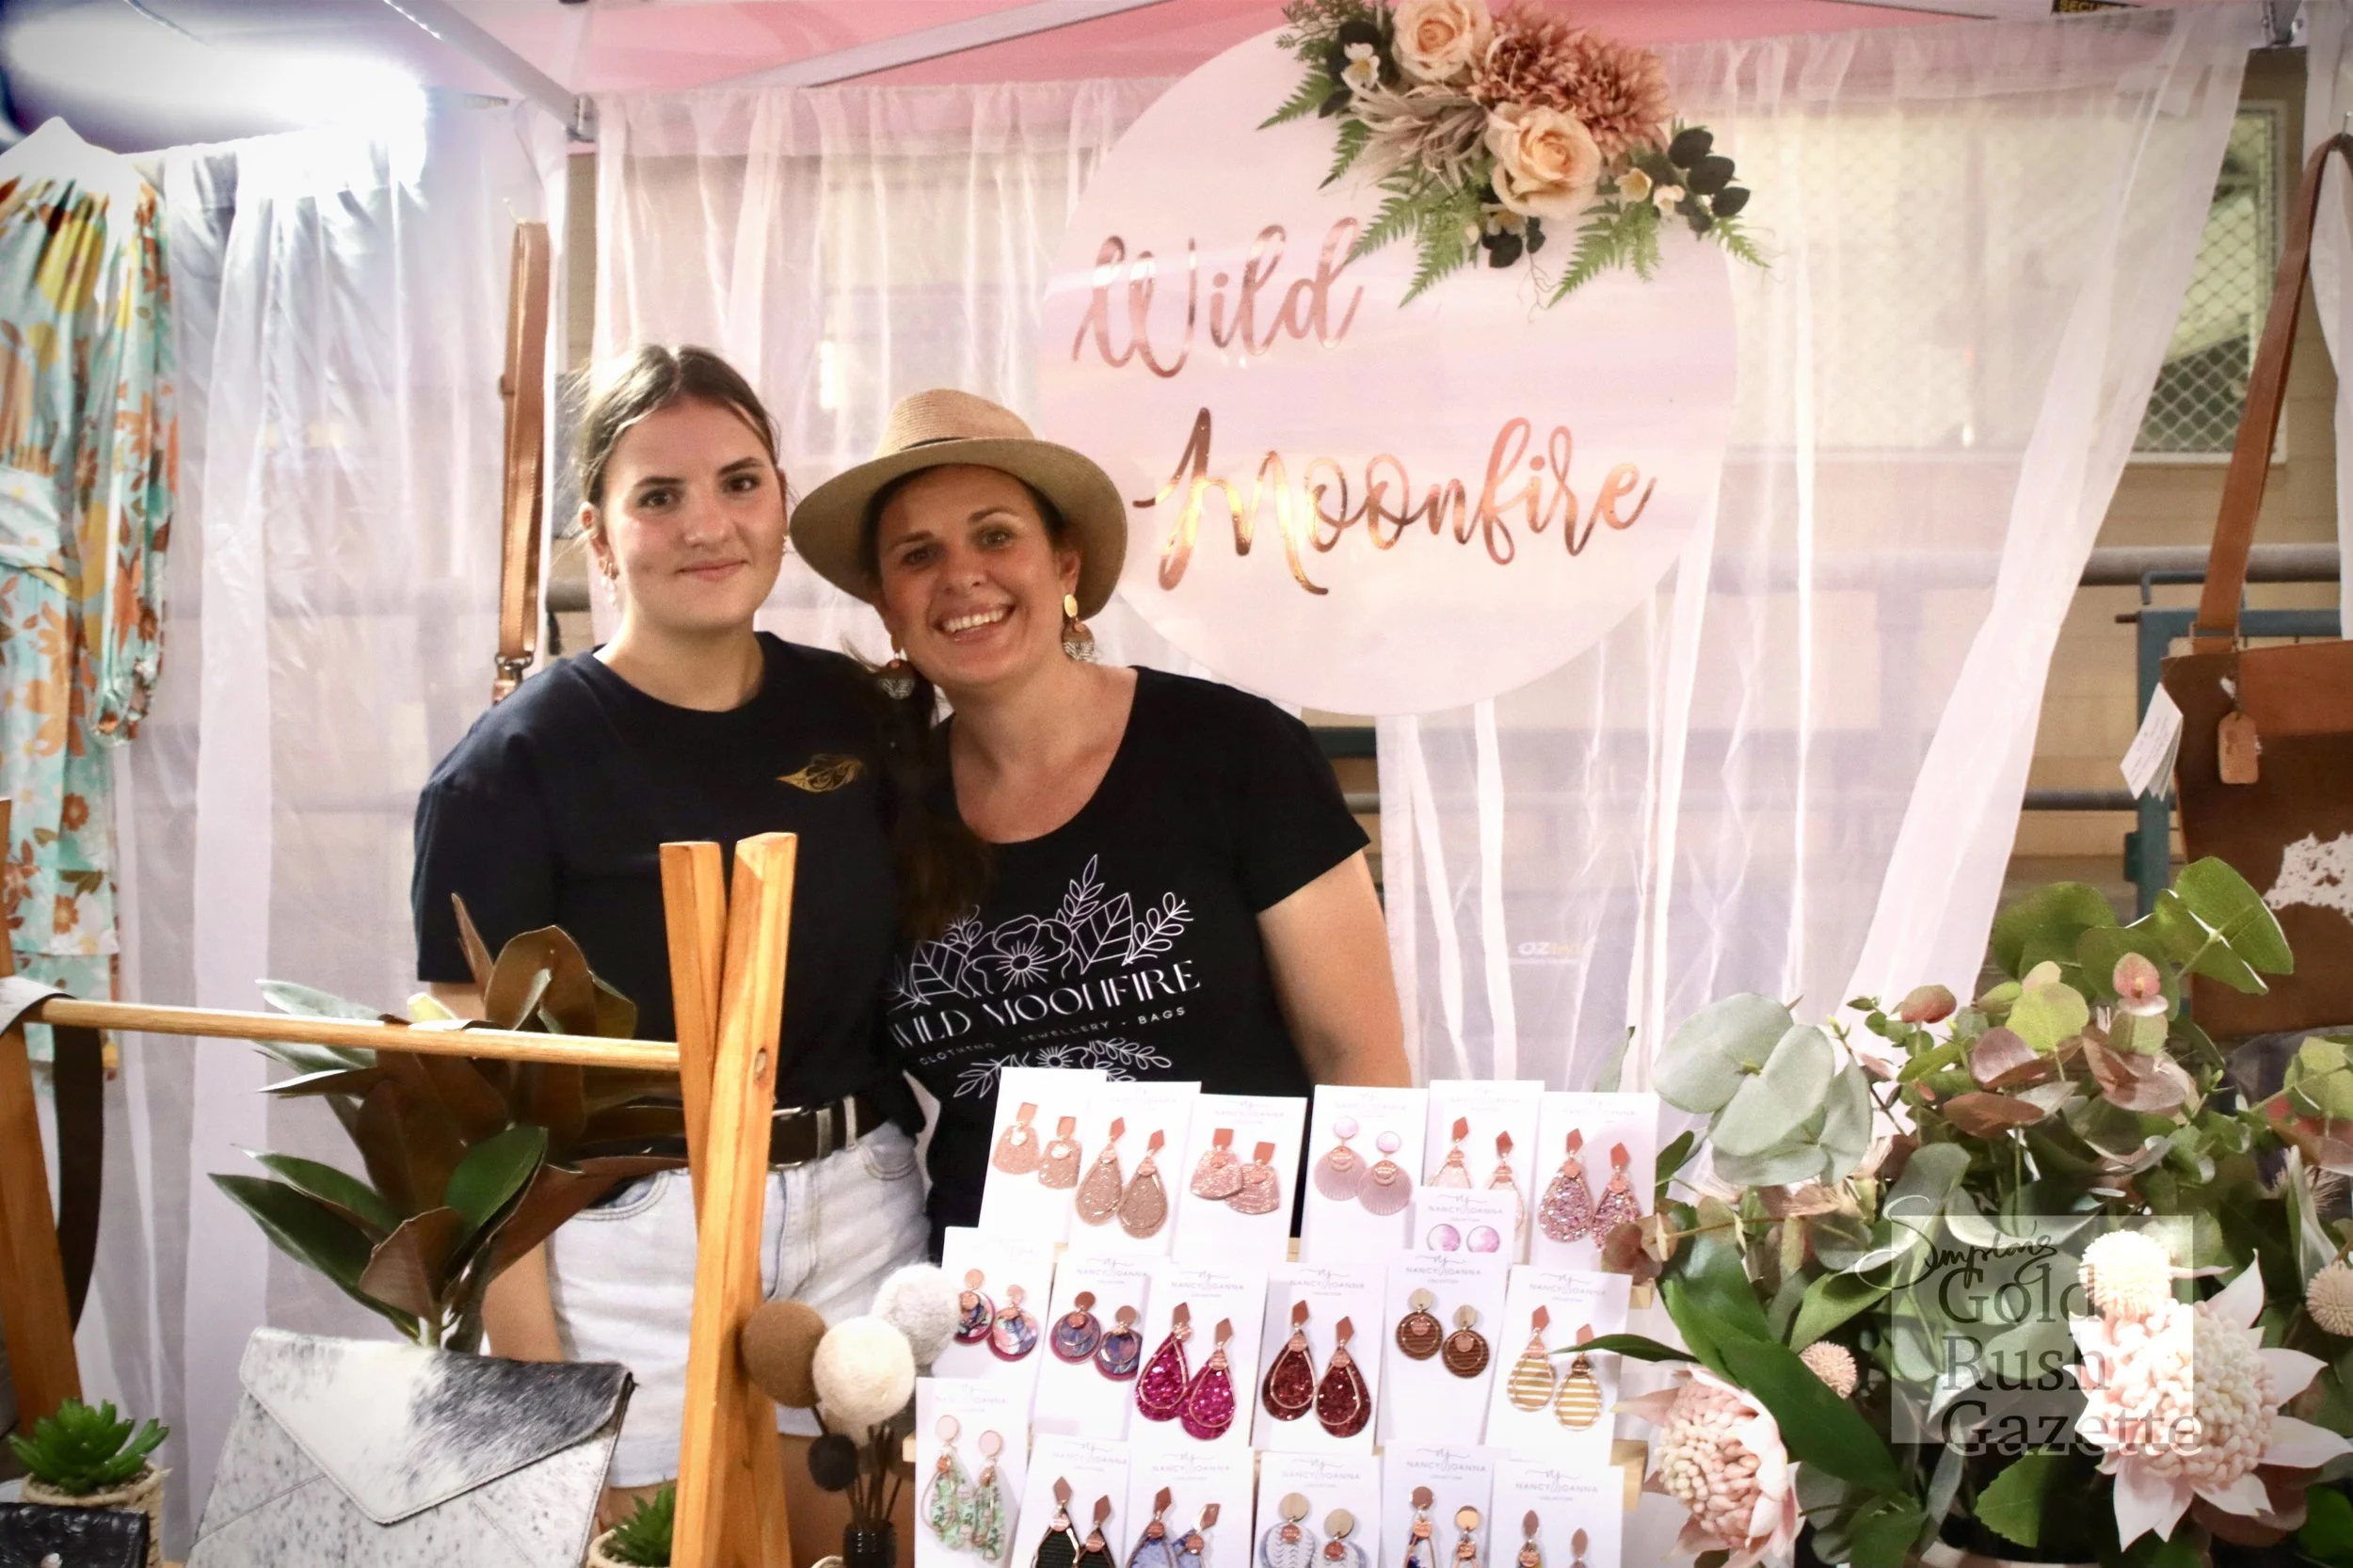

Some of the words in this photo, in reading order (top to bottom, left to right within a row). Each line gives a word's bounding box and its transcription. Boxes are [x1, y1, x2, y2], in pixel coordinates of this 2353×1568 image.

[1072, 216, 1364, 378] Wild
[1133, 407, 1657, 596] Moonfire
[1137, 1006, 1186, 1025] BAGS
